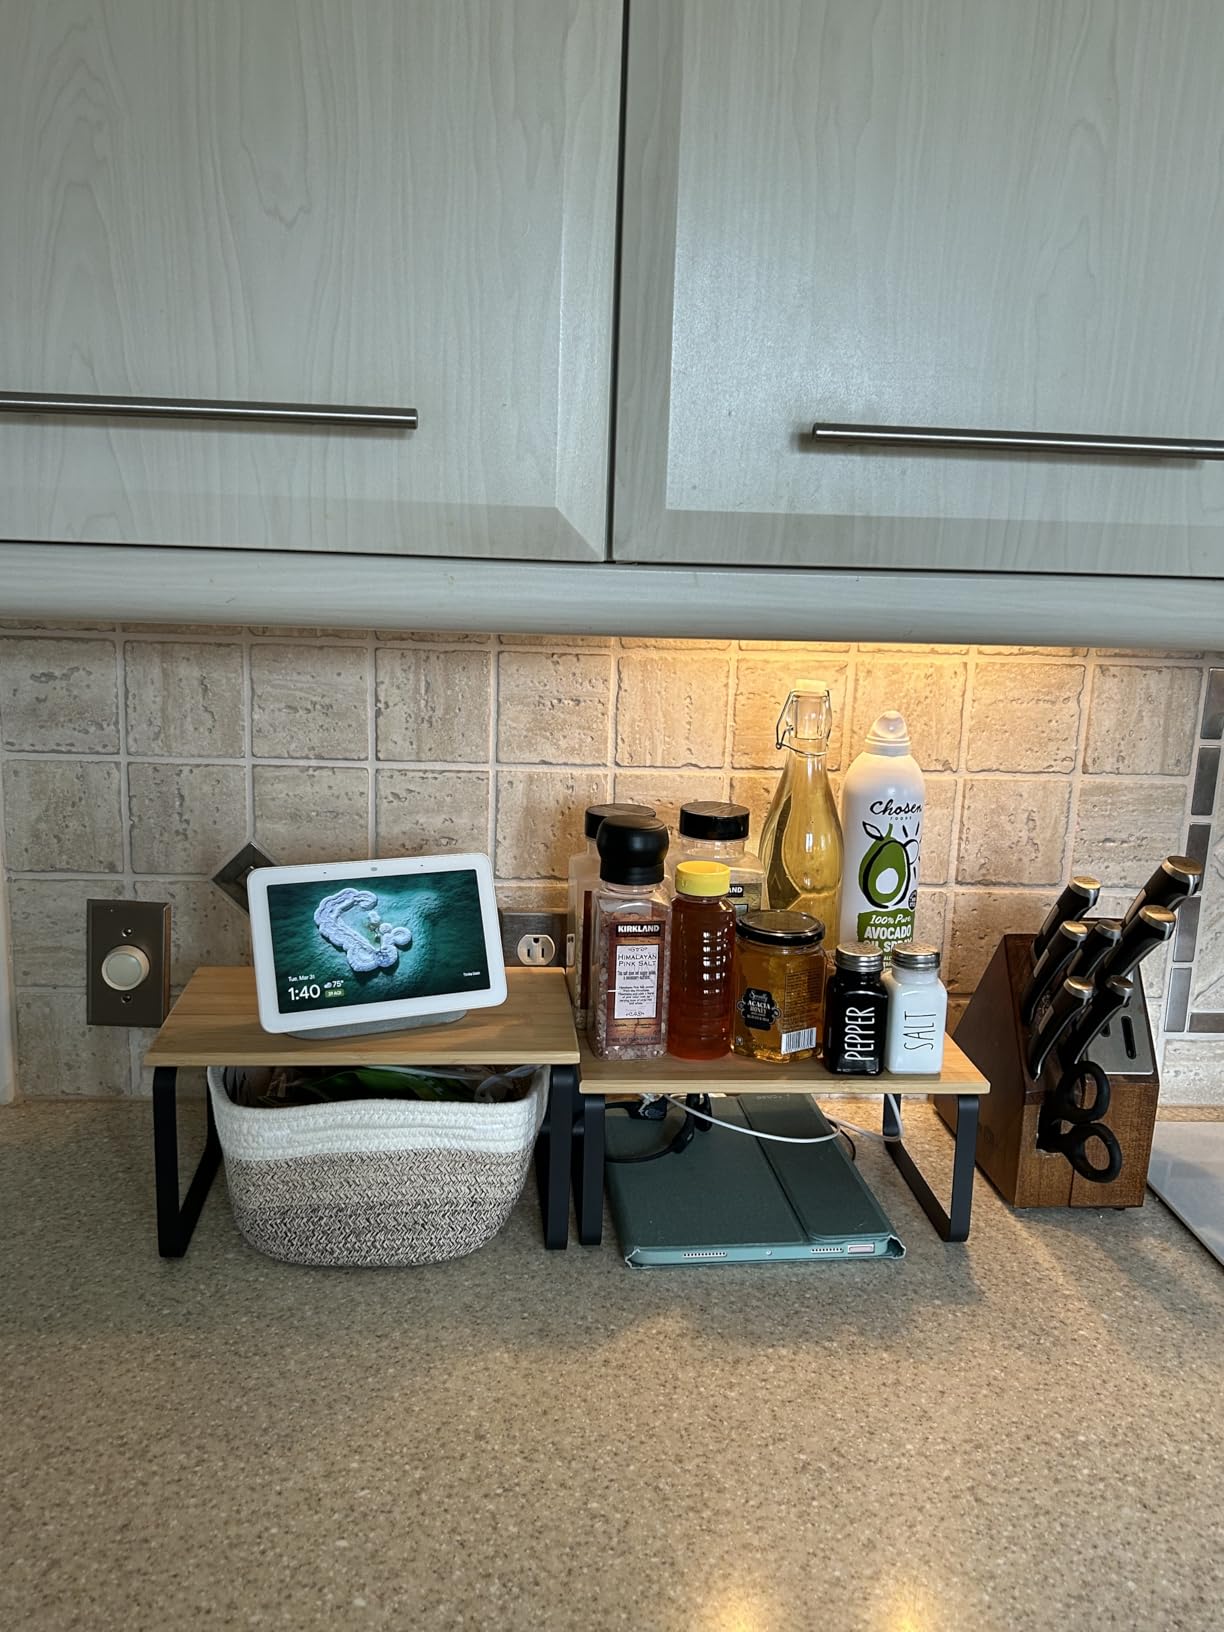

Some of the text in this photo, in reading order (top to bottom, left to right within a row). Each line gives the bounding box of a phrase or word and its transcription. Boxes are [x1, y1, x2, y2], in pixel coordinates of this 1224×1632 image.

[870, 799, 922, 815] Chosen
[870, 914, 912, 924] 100% Pure
[617, 925, 660, 933] KIRKLAND
[864, 924, 912, 940] AVOCADO
[288, 984, 321, 1001] 1:40
[747, 1000, 770, 1010] ACACIA
[844, 1007, 875, 1061] PEPPER
[903, 1010, 937, 1050] SALT
